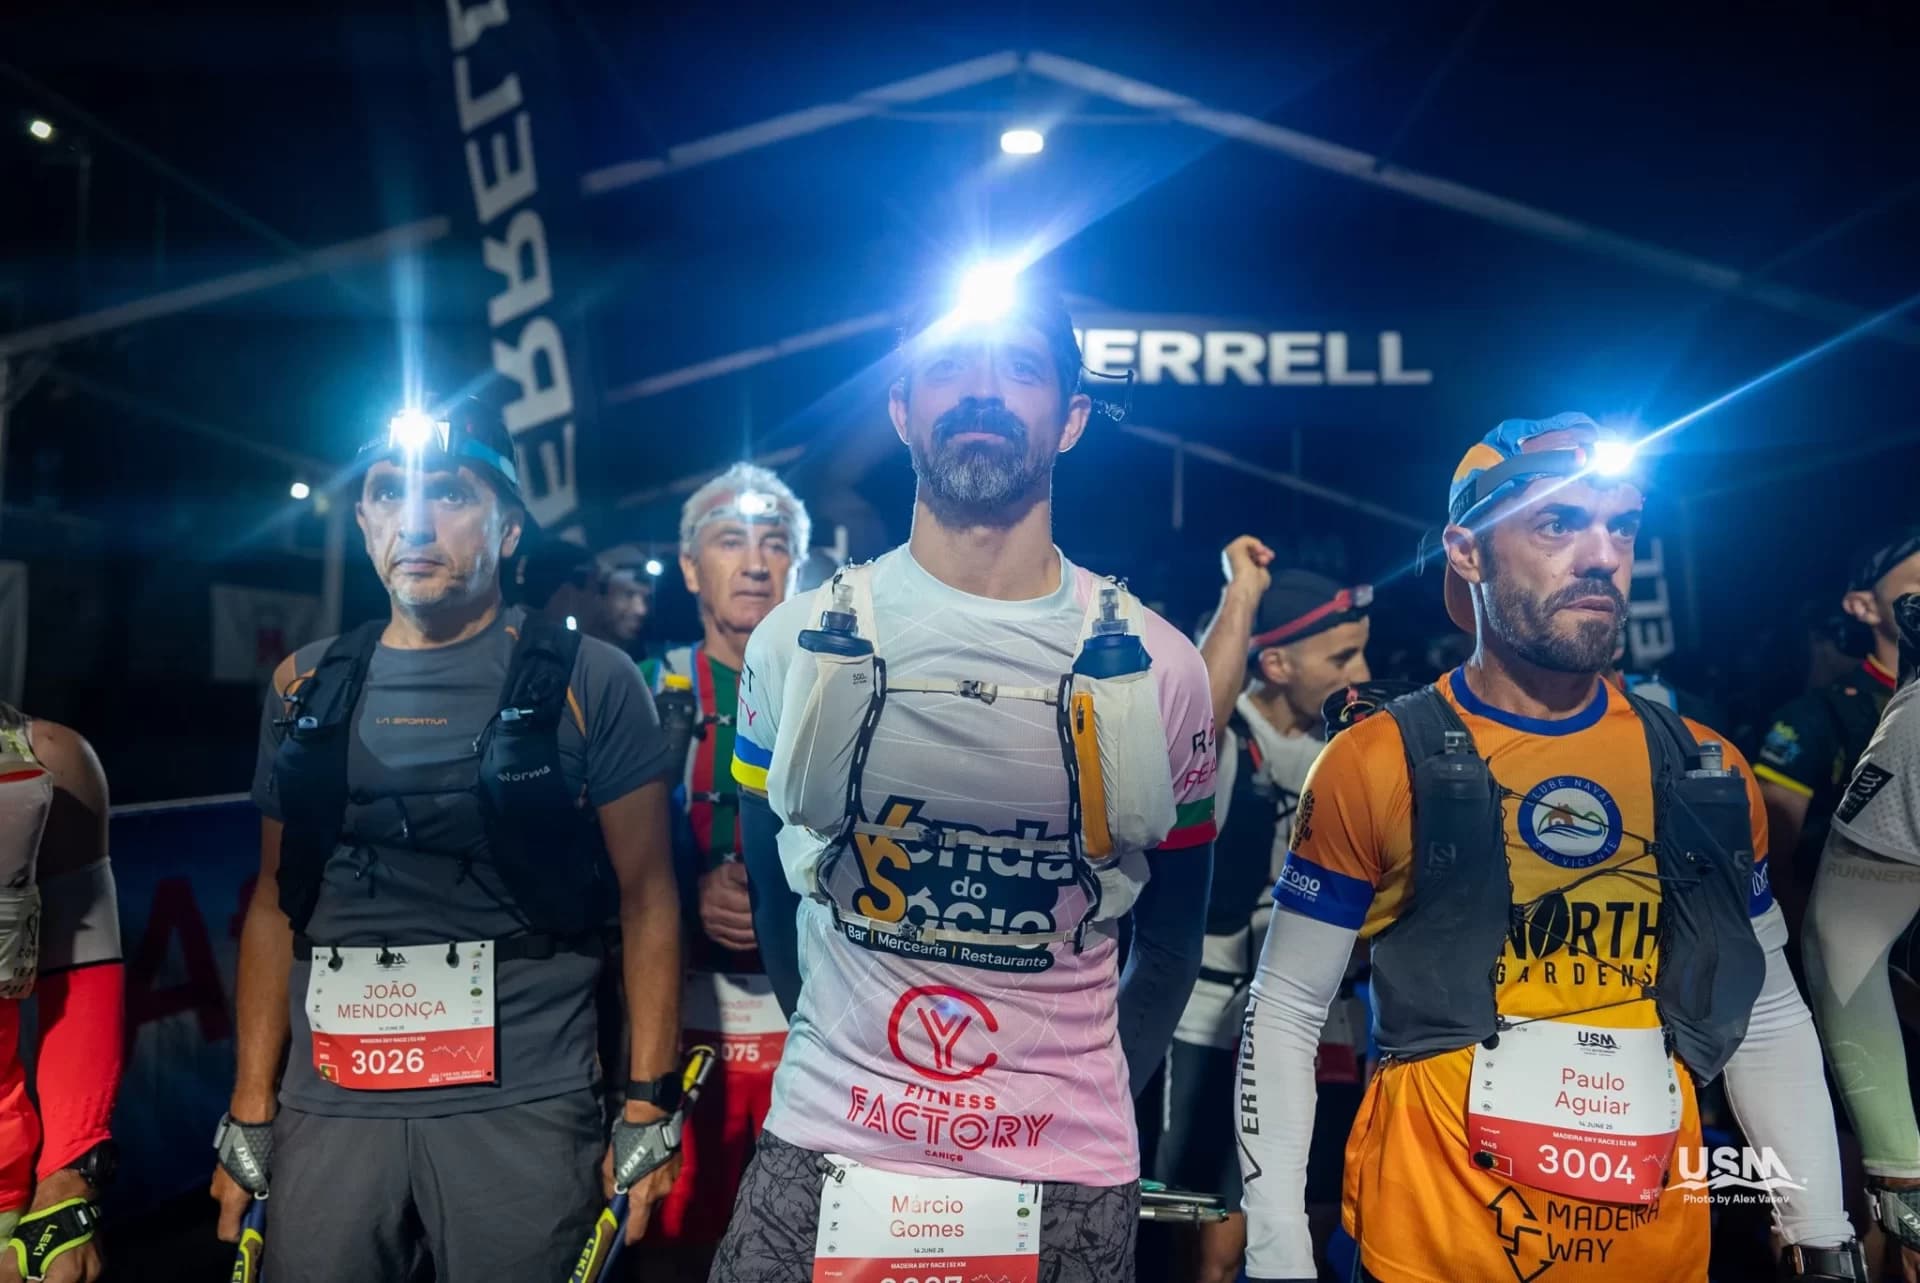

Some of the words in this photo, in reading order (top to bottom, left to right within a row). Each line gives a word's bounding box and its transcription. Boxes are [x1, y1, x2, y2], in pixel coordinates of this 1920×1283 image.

[1073, 328, 1432, 386] ERRELL
[1574, 778, 1612, 808] NAVAL
[950, 876, 987, 900] do
[847, 925, 868, 941] Bar
[877, 932, 947, 957] Mercearia
[960, 947, 1048, 968] Restaurante
[363, 980, 417, 999] JOÃO
[337, 1001, 447, 1020] MENDONÇA
[1578, 1031, 1616, 1046] USM
[351, 1048, 425, 1075] 3026
[1235, 1001, 1262, 1185] VERTICAL
[1562, 1068, 1625, 1091] Paulo
[905, 1083, 997, 1110] FITNESS
[1555, 1091, 1631, 1116] Aguiar
[847, 1086, 1054, 1151] FACTORY
[236, 1146, 259, 1177] LEKI
[620, 1145, 646, 1177] LEKI
[1538, 1144, 1635, 1184] 3004
[892, 1193, 963, 1214] Márcio
[1547, 1200, 1660, 1231] MADEIRA
[33, 1224, 58, 1256] LEKI
[890, 1219, 964, 1238] Gomes
[1547, 1233, 1613, 1262] WAY
